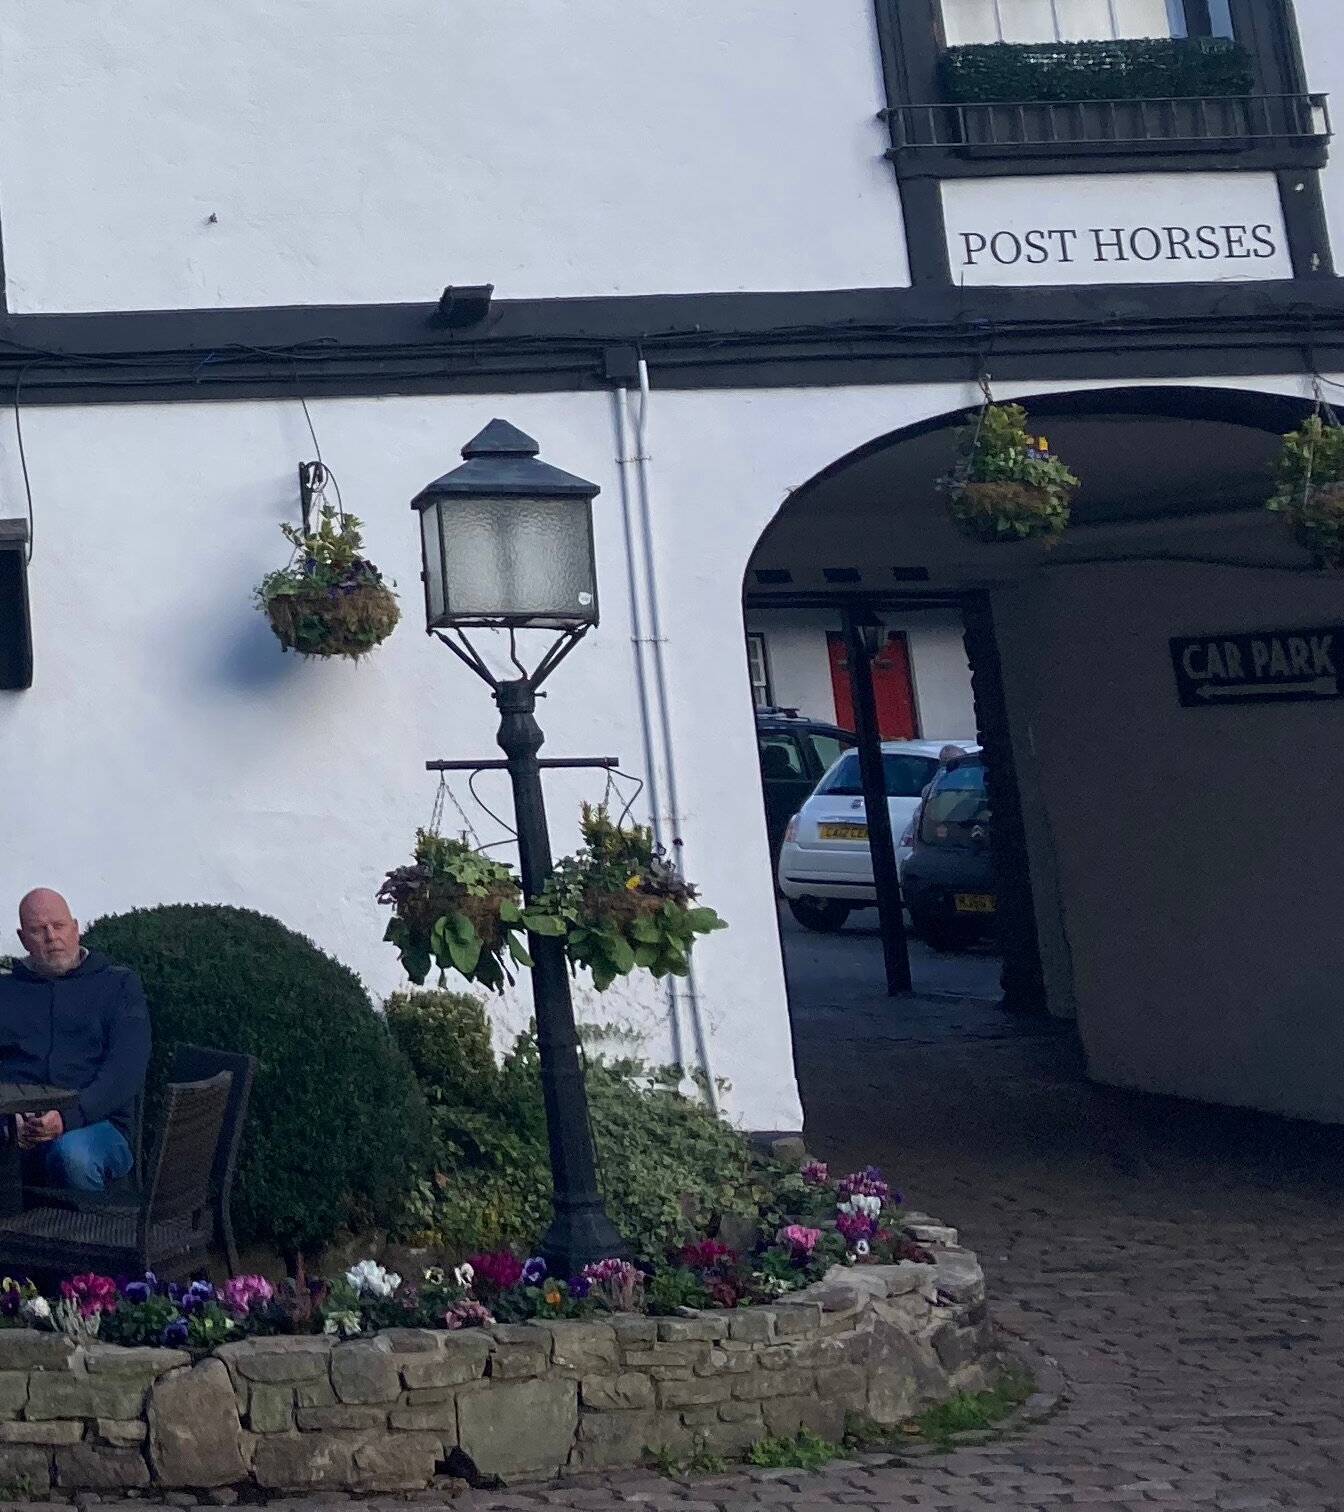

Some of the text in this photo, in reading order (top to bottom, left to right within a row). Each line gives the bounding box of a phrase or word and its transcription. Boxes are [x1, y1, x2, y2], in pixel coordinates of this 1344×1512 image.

[959, 223, 1277, 266] POST HORSES
[1182, 634, 1337, 680] CAR PARK
